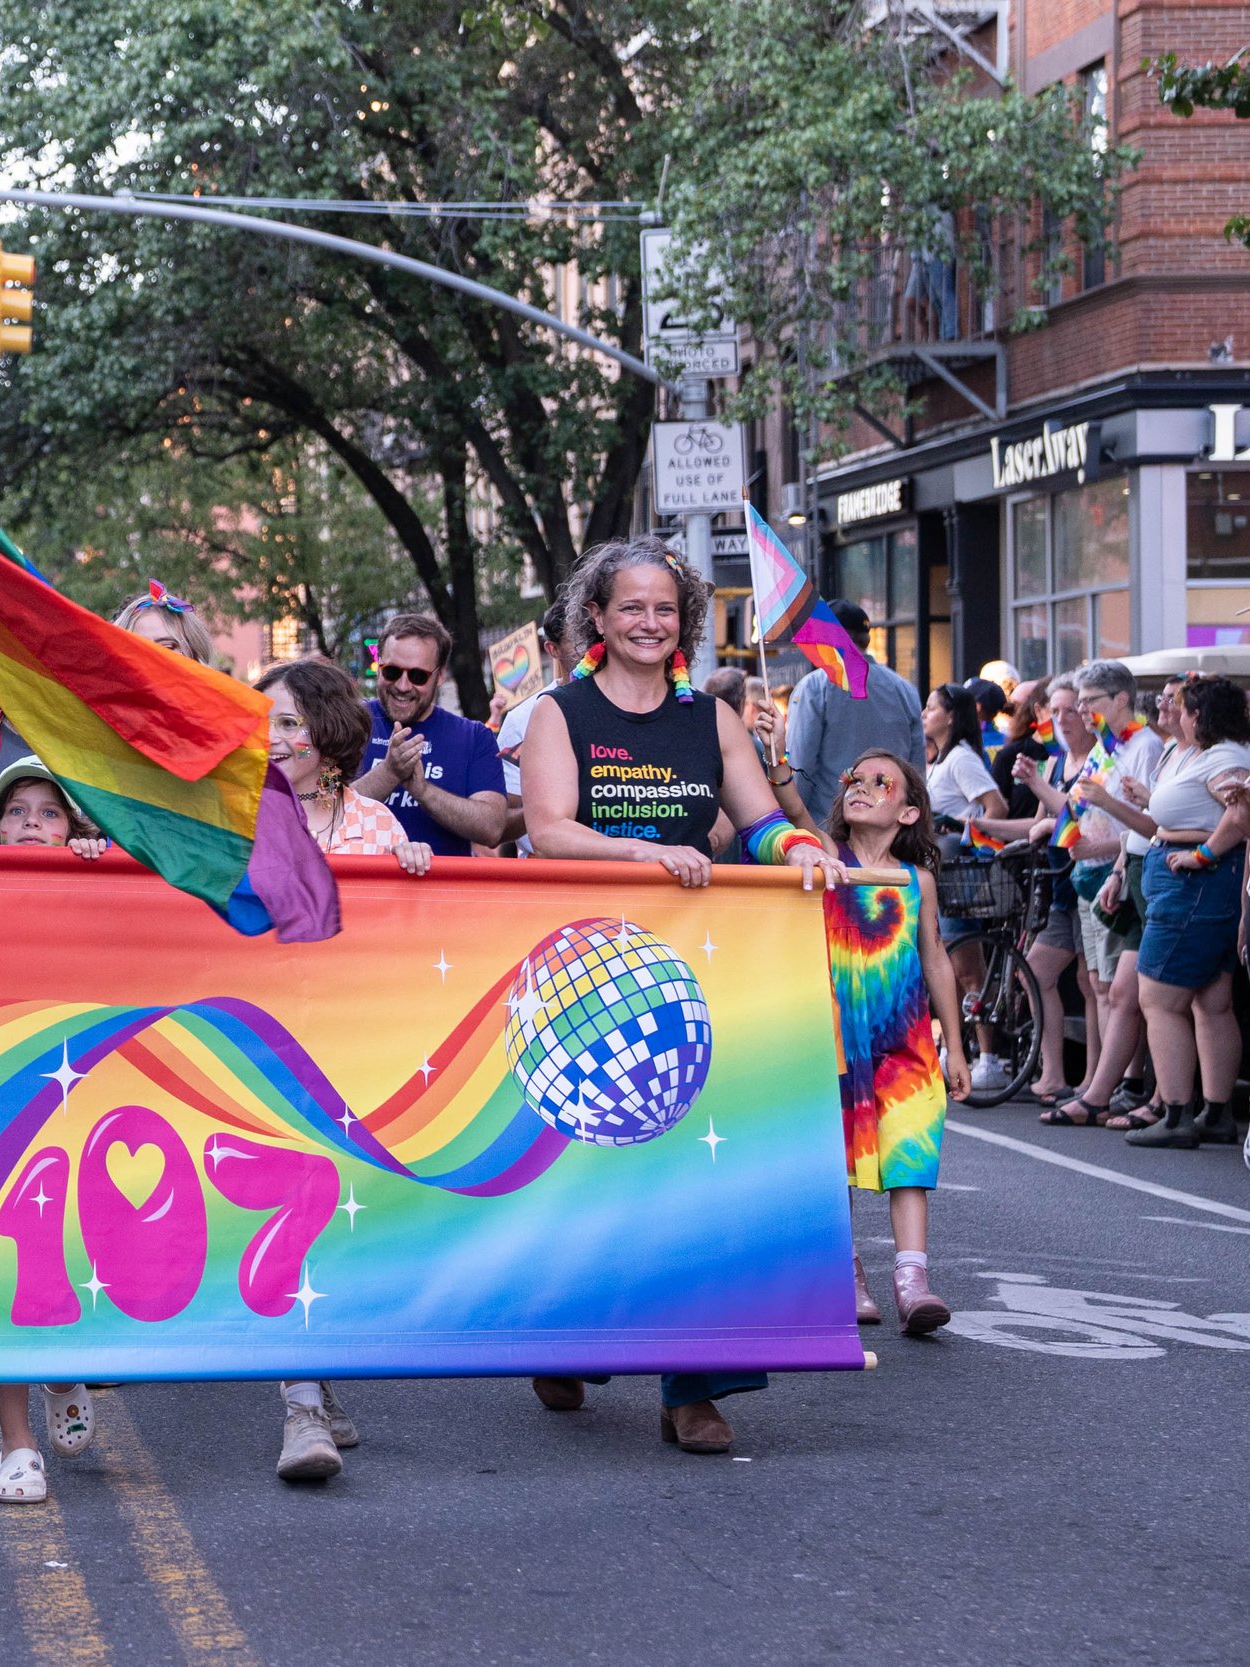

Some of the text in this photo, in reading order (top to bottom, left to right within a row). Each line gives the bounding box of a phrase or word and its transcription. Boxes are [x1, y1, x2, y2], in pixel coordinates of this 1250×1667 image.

[667, 455, 731, 469] ALLOWED
[990, 418, 1091, 489] LaserAway
[676, 473, 725, 487] USE OF
[663, 490, 738, 505] FULL LANE
[836, 479, 902, 525] FRAMEBRIDGE
[714, 538, 747, 552] WAY
[590, 743, 633, 760] love.
[424, 762, 444, 779] is
[590, 764, 677, 783] empathy.
[591, 781, 714, 802] compassion.
[591, 801, 689, 818] inclusion.
